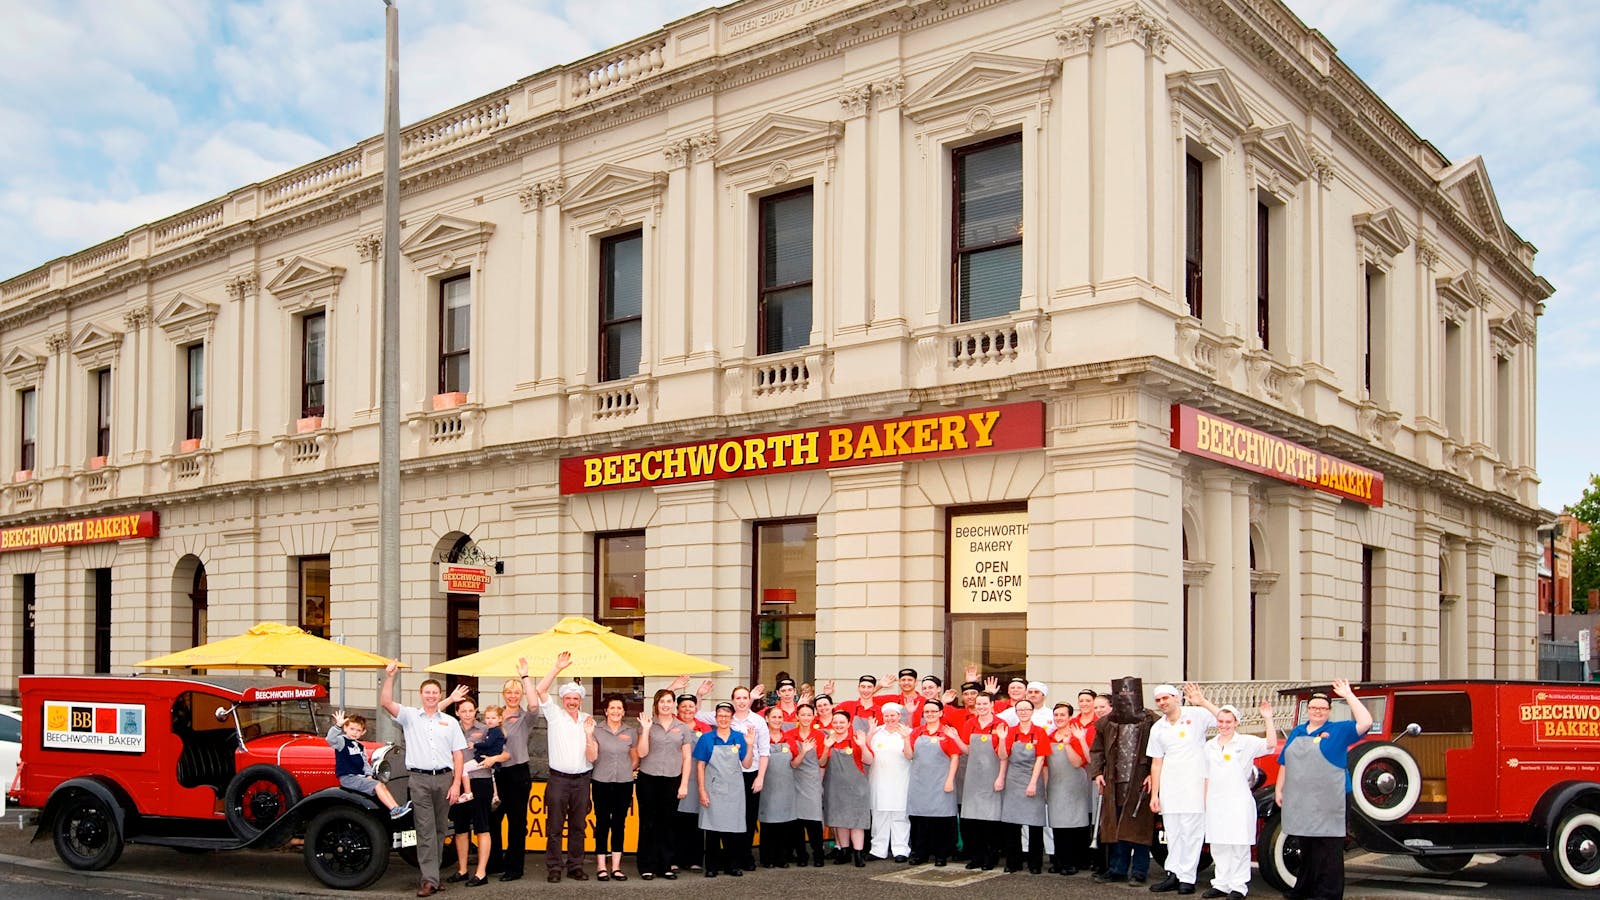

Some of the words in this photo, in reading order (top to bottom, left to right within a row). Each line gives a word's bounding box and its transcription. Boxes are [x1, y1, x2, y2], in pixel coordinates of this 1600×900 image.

[760, 4, 796, 26] SUPPLY
[584, 431, 820, 487] BEECHWORTH
[829, 410, 1001, 462] BAKERY
[1197, 414, 1318, 484] BEECHWORTH
[1320, 456, 1375, 499] BAKERY
[1, 522, 84, 548] BEECHWORTH
[86, 514, 140, 540] BAKERY
[975, 561, 1009, 573] OPEN
[443, 573, 490, 584] BEECHWORTH
[452, 580, 481, 589] BAKERY
[962, 576, 987, 588] 6AM
[997, 575, 1022, 587] 6PM
[971, 591, 978, 602] 7
[981, 590, 1012, 602] DAYS
[255, 690, 294, 699] BEECHWORTH
[295, 689, 316, 697] BAKERY
[73, 711, 92, 728] BB
[1544, 721, 1600, 737] BAKER
[46, 732, 103, 744] BEECHWORTH
[108, 735, 142, 746] BAKERY
